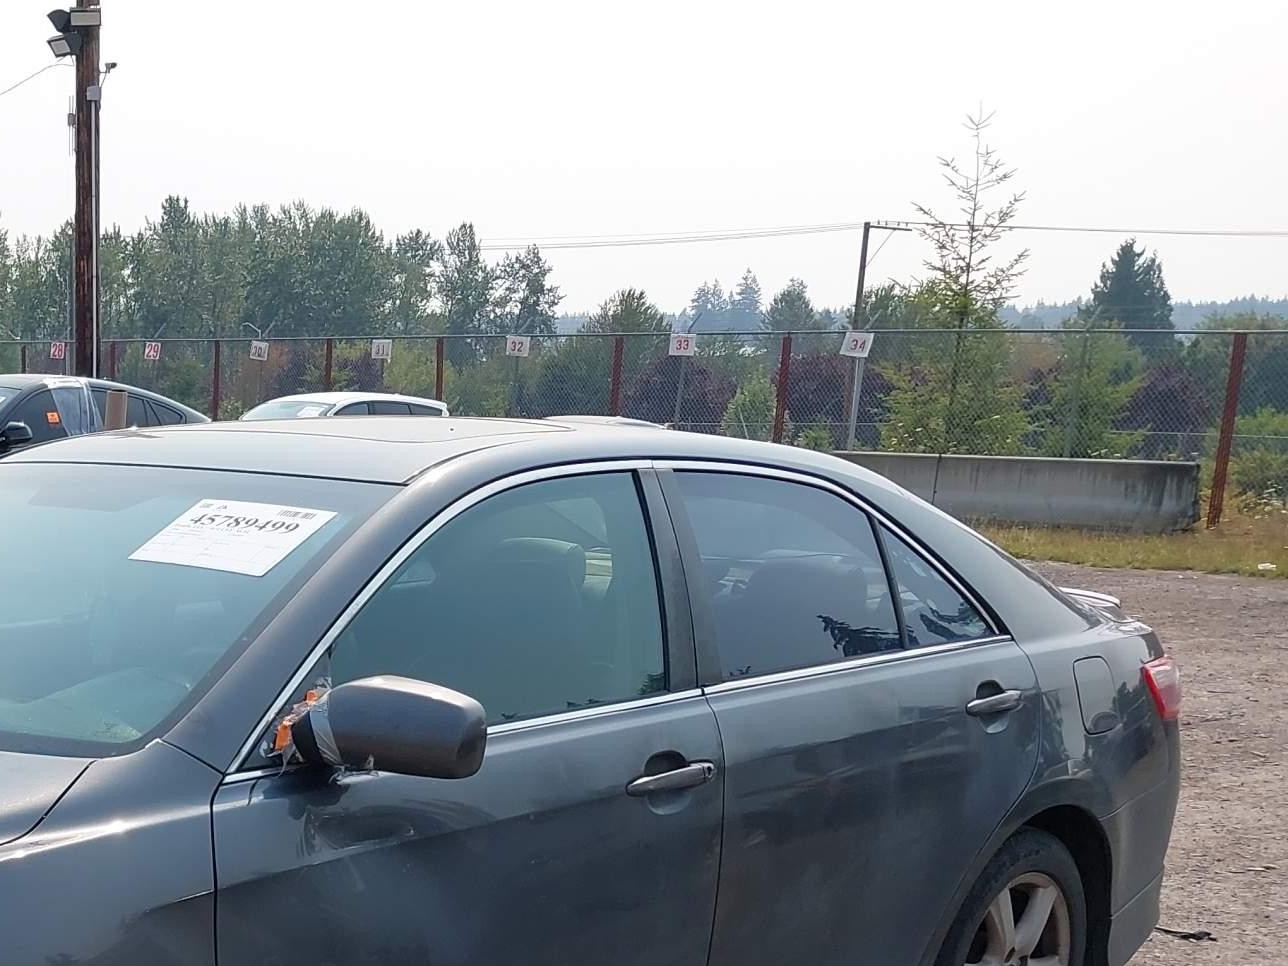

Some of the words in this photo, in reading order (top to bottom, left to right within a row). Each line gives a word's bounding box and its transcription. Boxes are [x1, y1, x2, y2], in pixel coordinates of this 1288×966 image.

[52, 343, 63, 357] 28
[146, 343, 159, 358] 29
[510, 341, 523, 352] 32
[676, 339, 689, 350] 33
[850, 339, 866, 351] 34
[189, 513, 300, 534] 45789499
